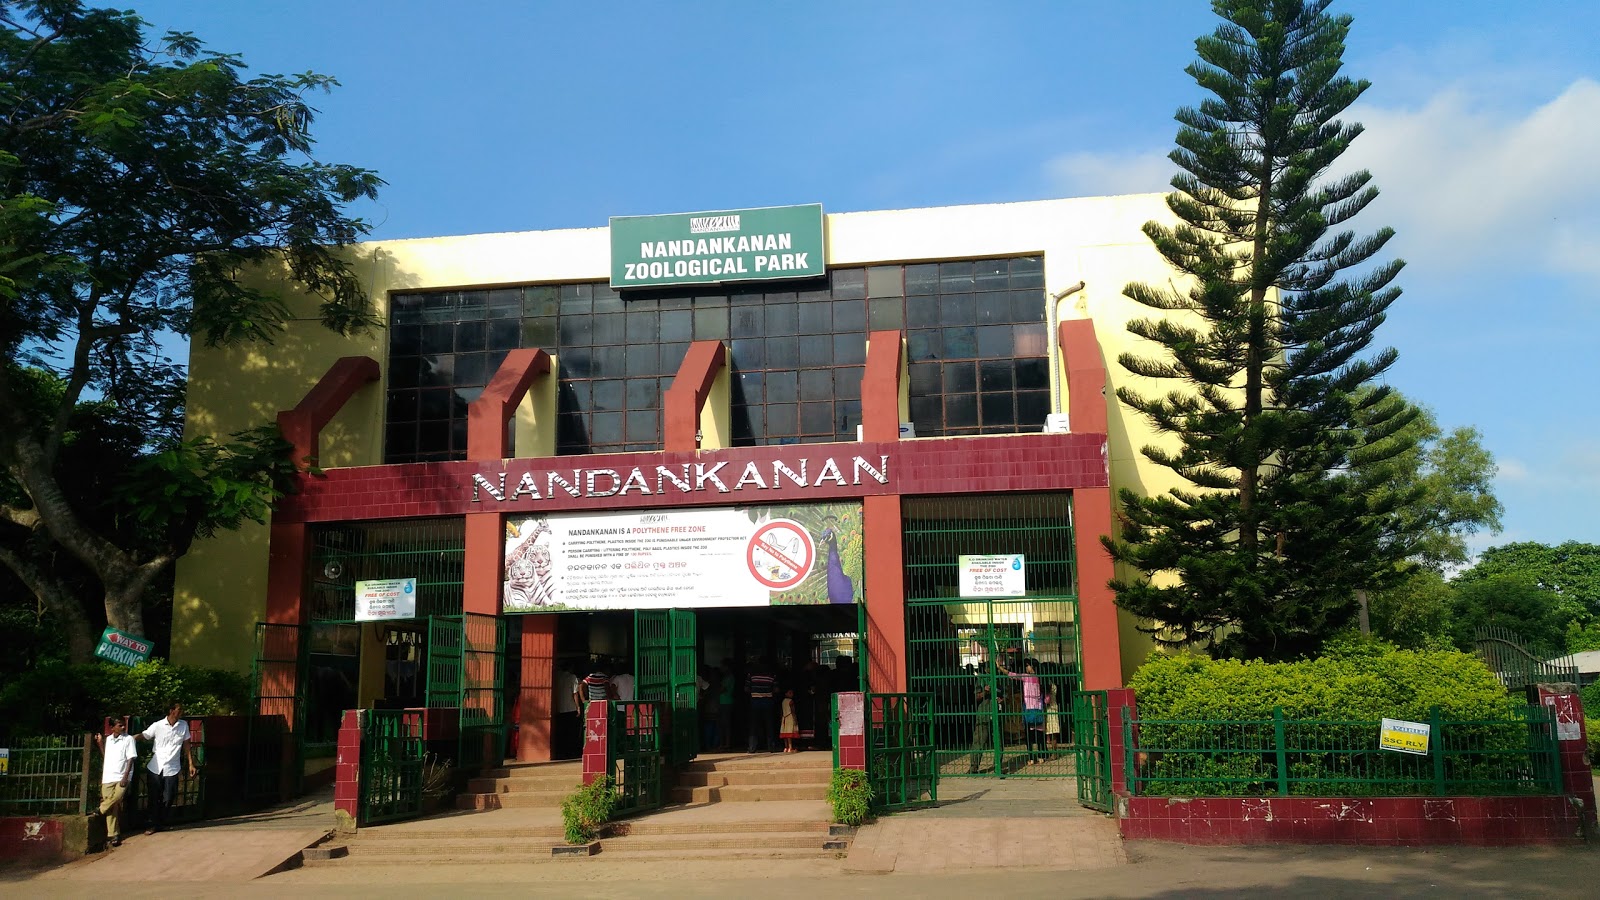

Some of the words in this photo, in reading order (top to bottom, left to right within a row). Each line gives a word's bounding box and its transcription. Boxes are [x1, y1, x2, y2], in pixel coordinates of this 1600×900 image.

[640, 233, 792, 258] NANDANKANAN
[624, 257, 748, 280] ZOOLOGICAL
[754, 252, 808, 272] PARK
[472, 456, 889, 502] NANDANKANAN
[568, 528, 618, 536] NANDANKANAN
[117, 636, 134, 649] WAY
[135, 642, 146, 652] TO
